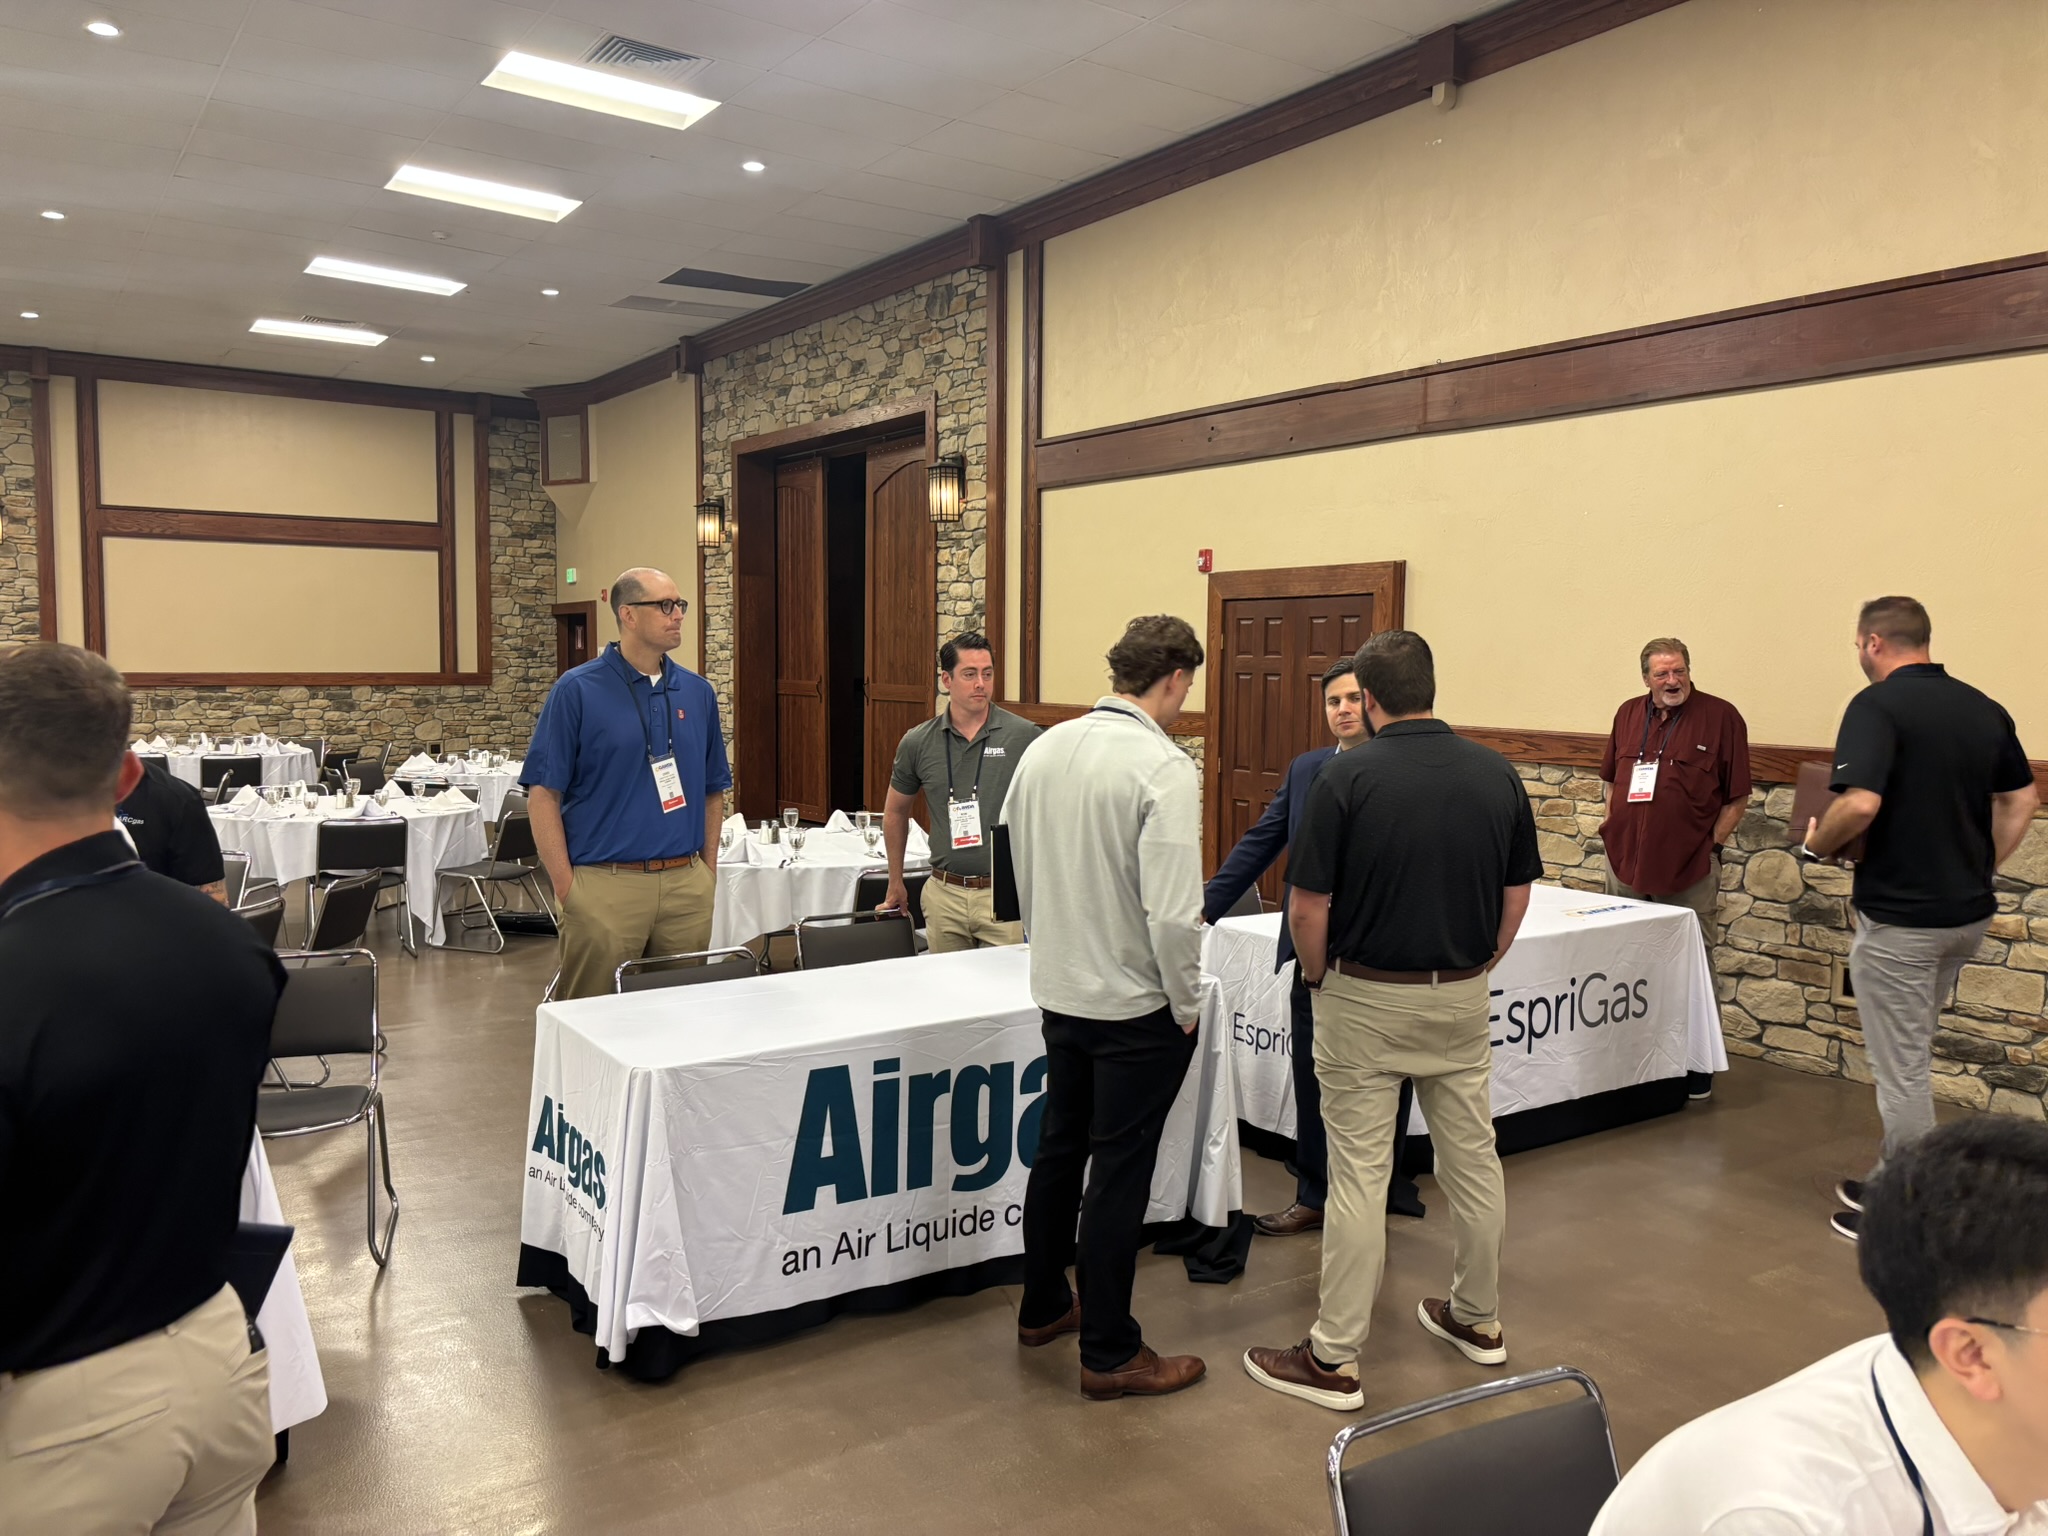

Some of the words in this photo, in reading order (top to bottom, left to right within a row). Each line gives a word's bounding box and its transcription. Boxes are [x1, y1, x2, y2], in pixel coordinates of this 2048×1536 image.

[984, 746, 1004, 755] Airgas
[1233, 1012, 1293, 1058] Espri
[1488, 972, 1648, 1055] EspriGas
[532, 1095, 607, 1210] Airgas
[782, 1056, 1048, 1216] Airga
[528, 1166, 543, 1181] an
[544, 1170, 557, 1188] Air
[782, 1245, 821, 1276] an
[831, 1228, 877, 1265] Air
[886, 1205, 995, 1253] Liquide
